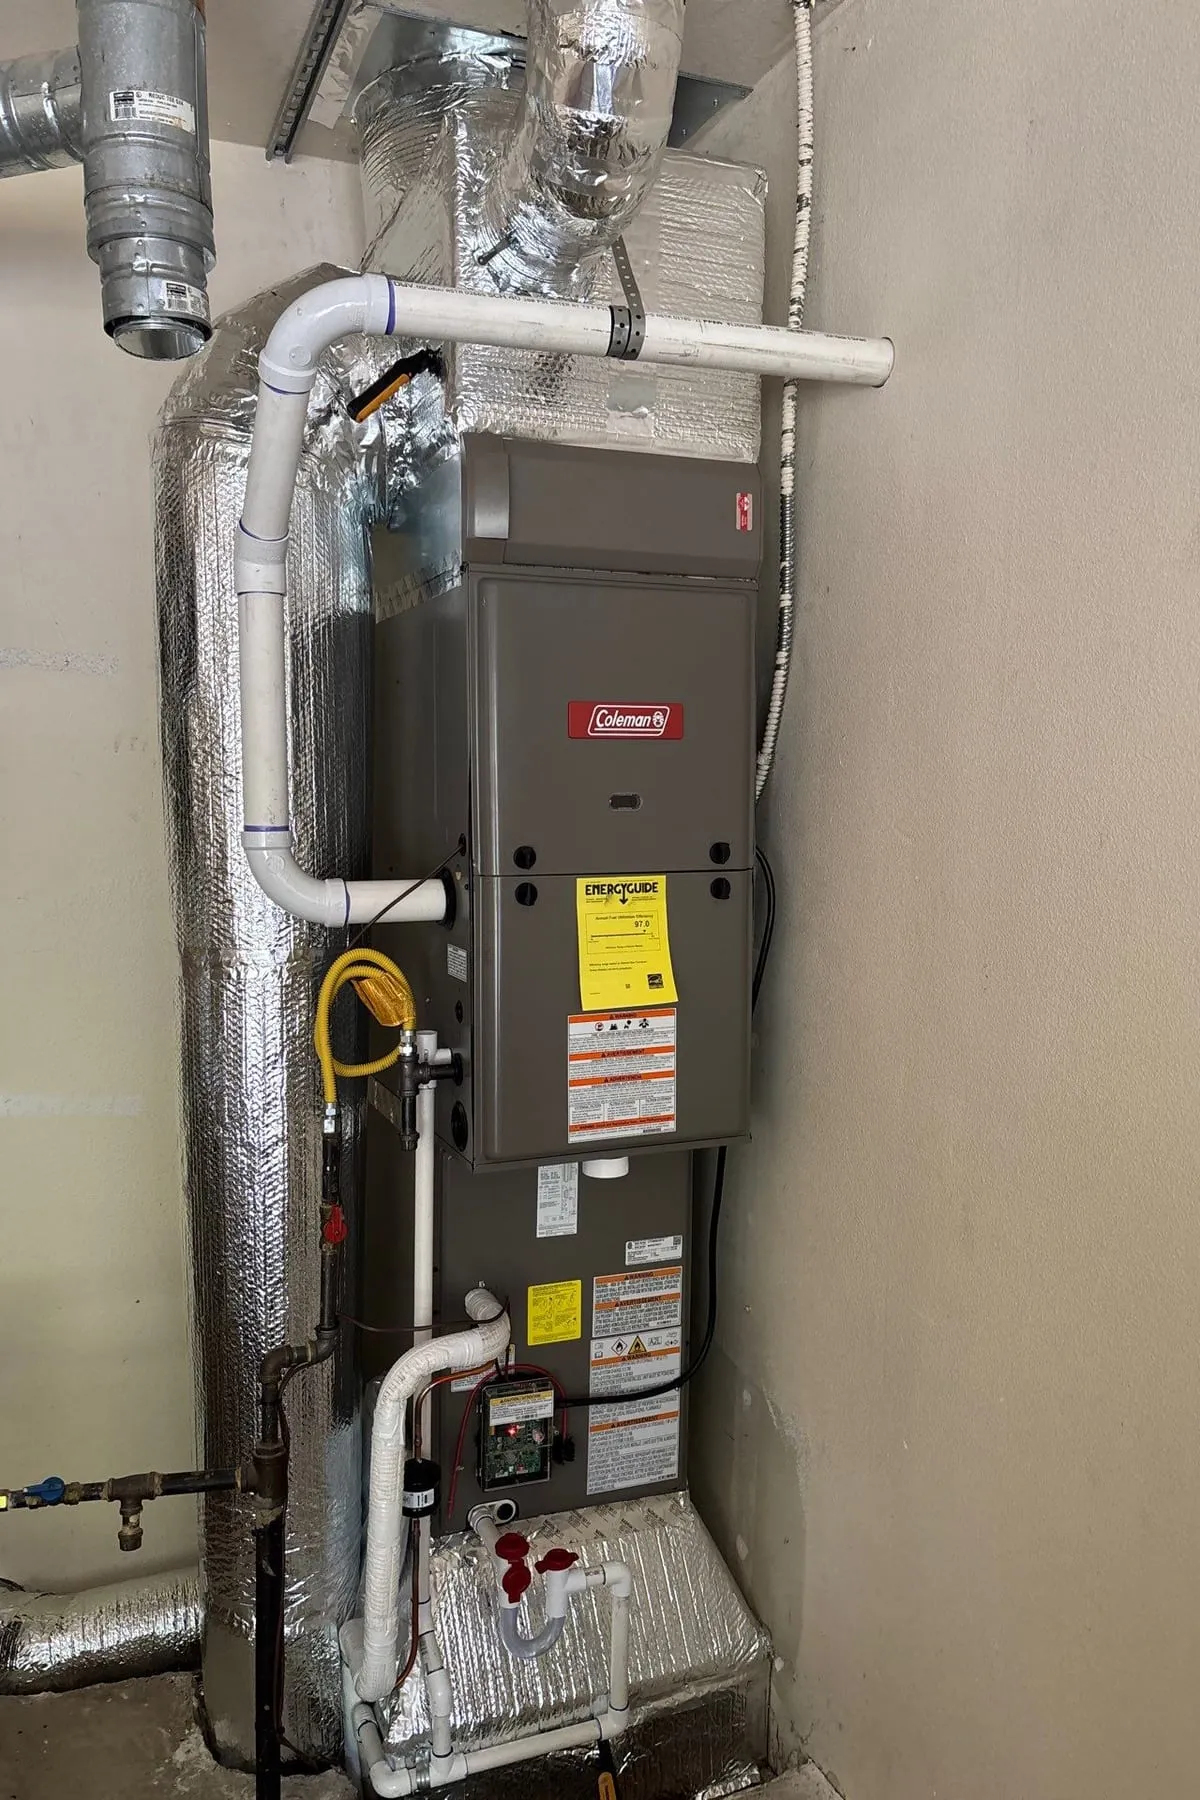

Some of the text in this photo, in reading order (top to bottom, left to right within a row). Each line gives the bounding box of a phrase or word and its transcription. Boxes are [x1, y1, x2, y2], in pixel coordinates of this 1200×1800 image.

[595, 709, 652, 728] Coleman
[585, 882, 659, 899] ENERGYGUIDE
[634, 920, 650, 928] 97.0
[630, 1271, 654, 1280] WARNING
[620, 1296, 662, 1307] AVERTISSEMENT
[627, 1352, 652, 1361] WARNING
[616, 1415, 659, 1427] AVERTISSEMENT
